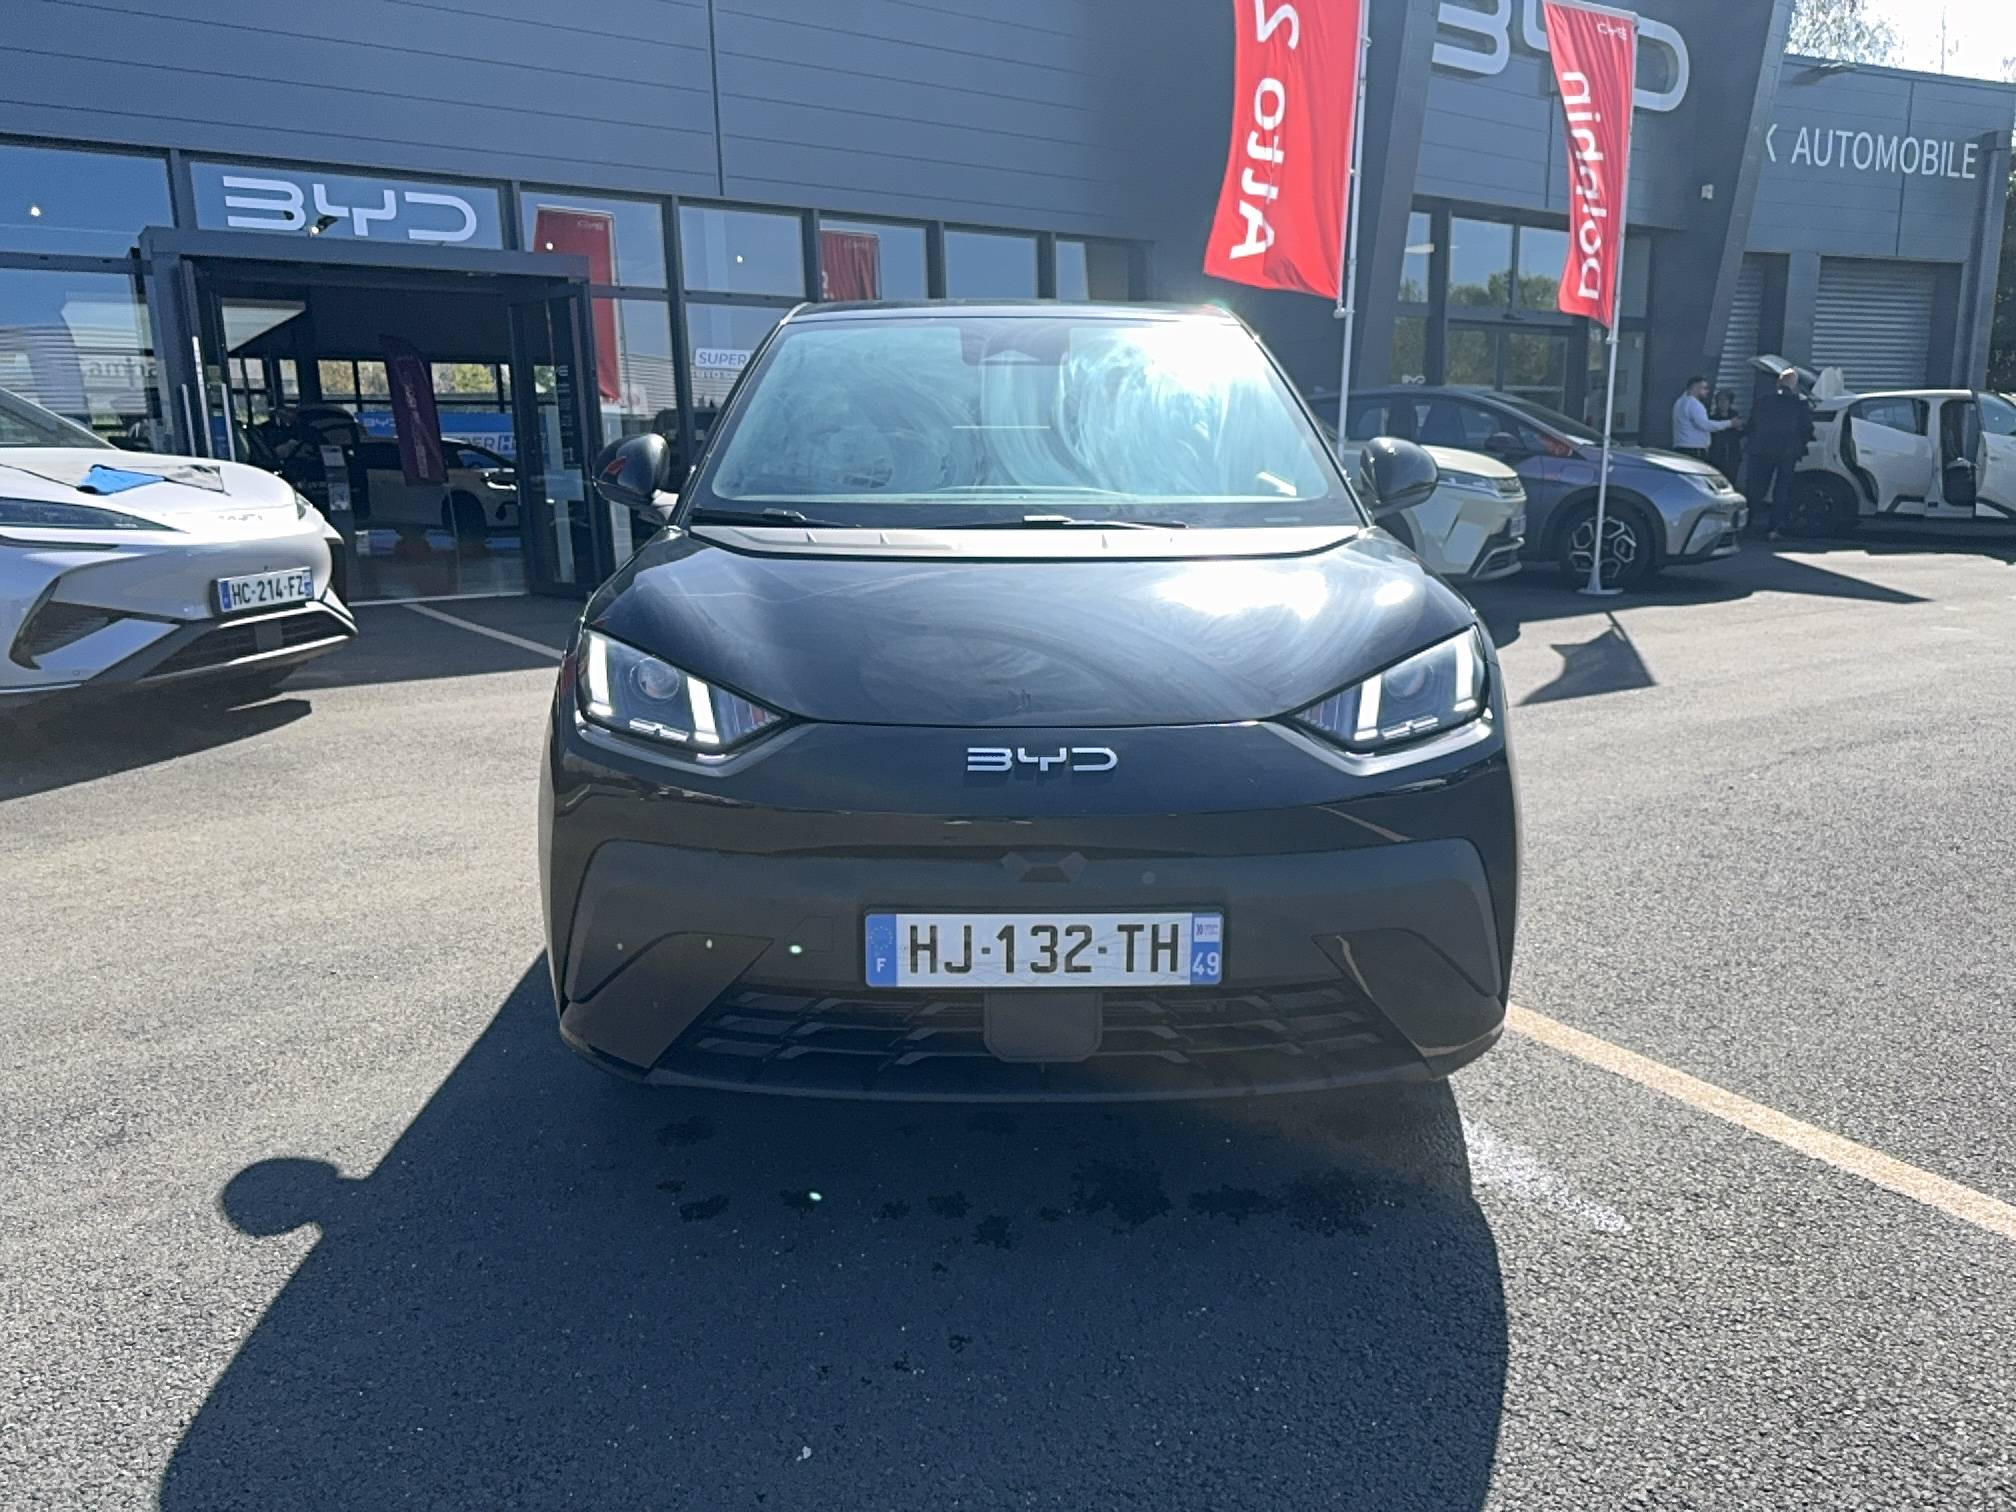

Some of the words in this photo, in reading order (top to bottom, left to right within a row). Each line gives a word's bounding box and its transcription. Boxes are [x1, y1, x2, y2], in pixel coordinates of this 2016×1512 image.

[1432, 0, 1690, 112] BD
[1790, 126, 1979, 179] AUTOMOBILE
[222, 176, 478, 242] BYD
[231, 575, 304, 605] HC-214-FZ
[967, 747, 1119, 772] BYD
[876, 957, 887, 973] F
[909, 924, 1179, 974] HJ-132-TH
[1192, 951, 1220, 976] 49
